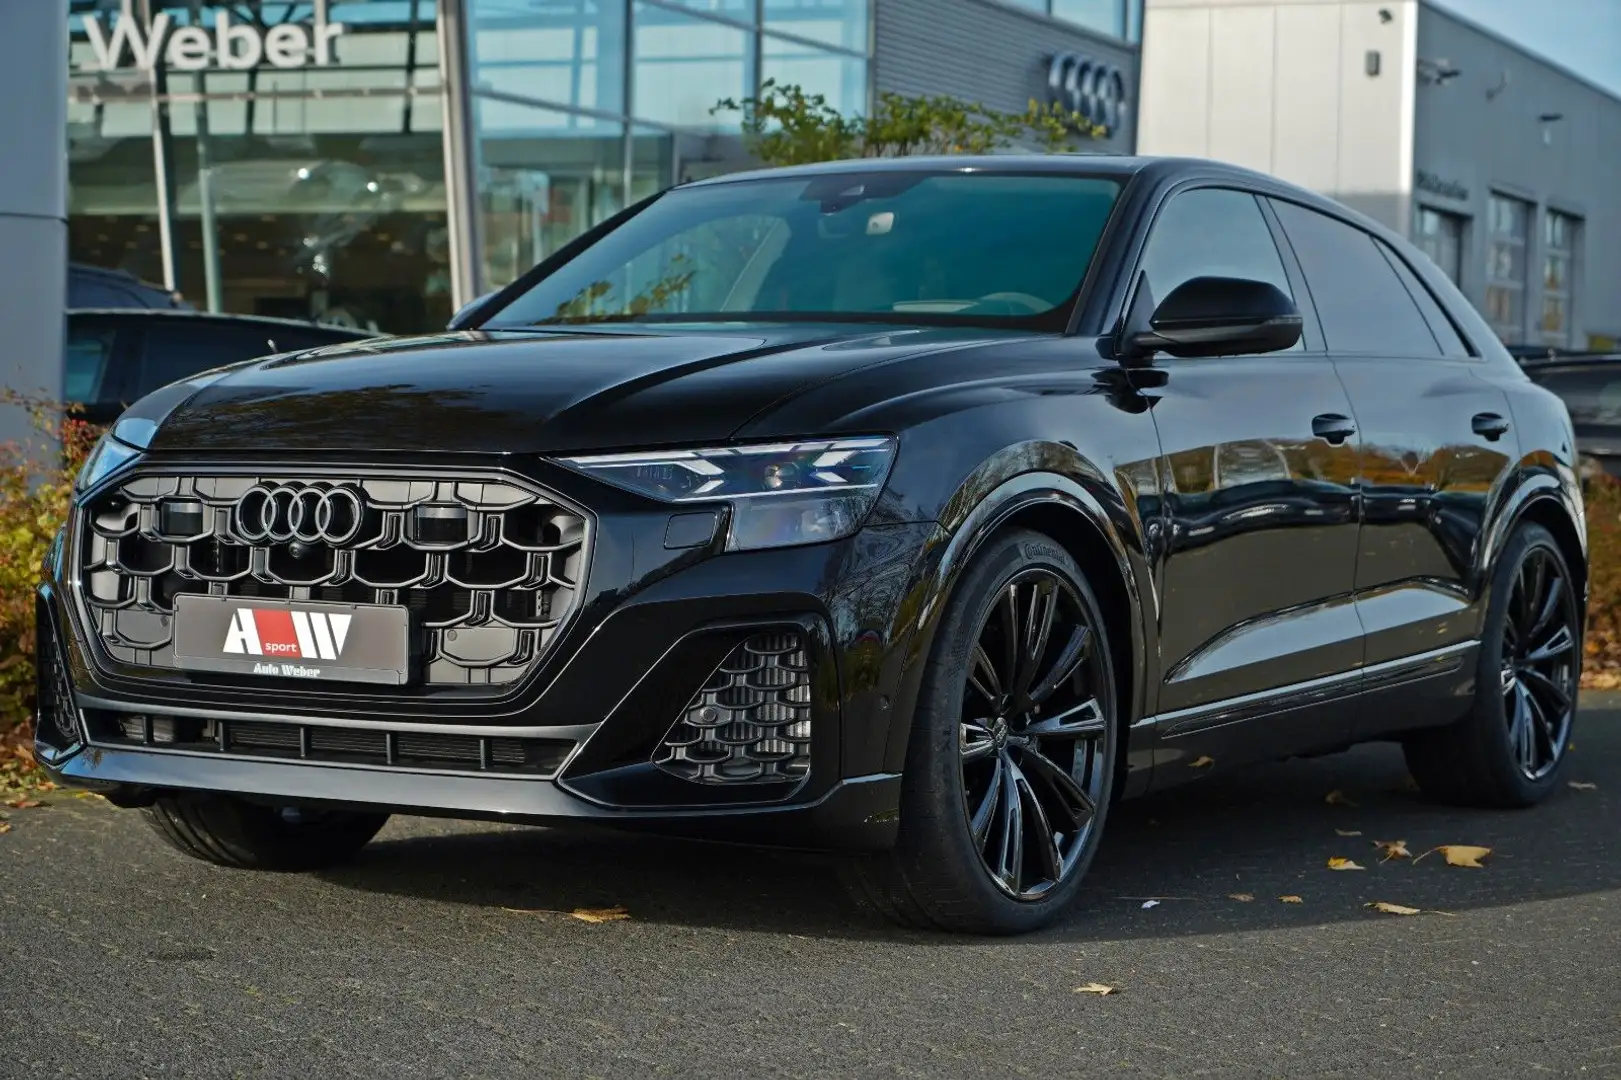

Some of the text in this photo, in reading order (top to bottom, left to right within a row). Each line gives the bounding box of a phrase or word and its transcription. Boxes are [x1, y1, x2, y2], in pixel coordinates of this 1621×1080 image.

[82, 10, 344, 70] Weber
[265, 642, 297, 653] sport
[253, 662, 321, 678] Auto Weber
